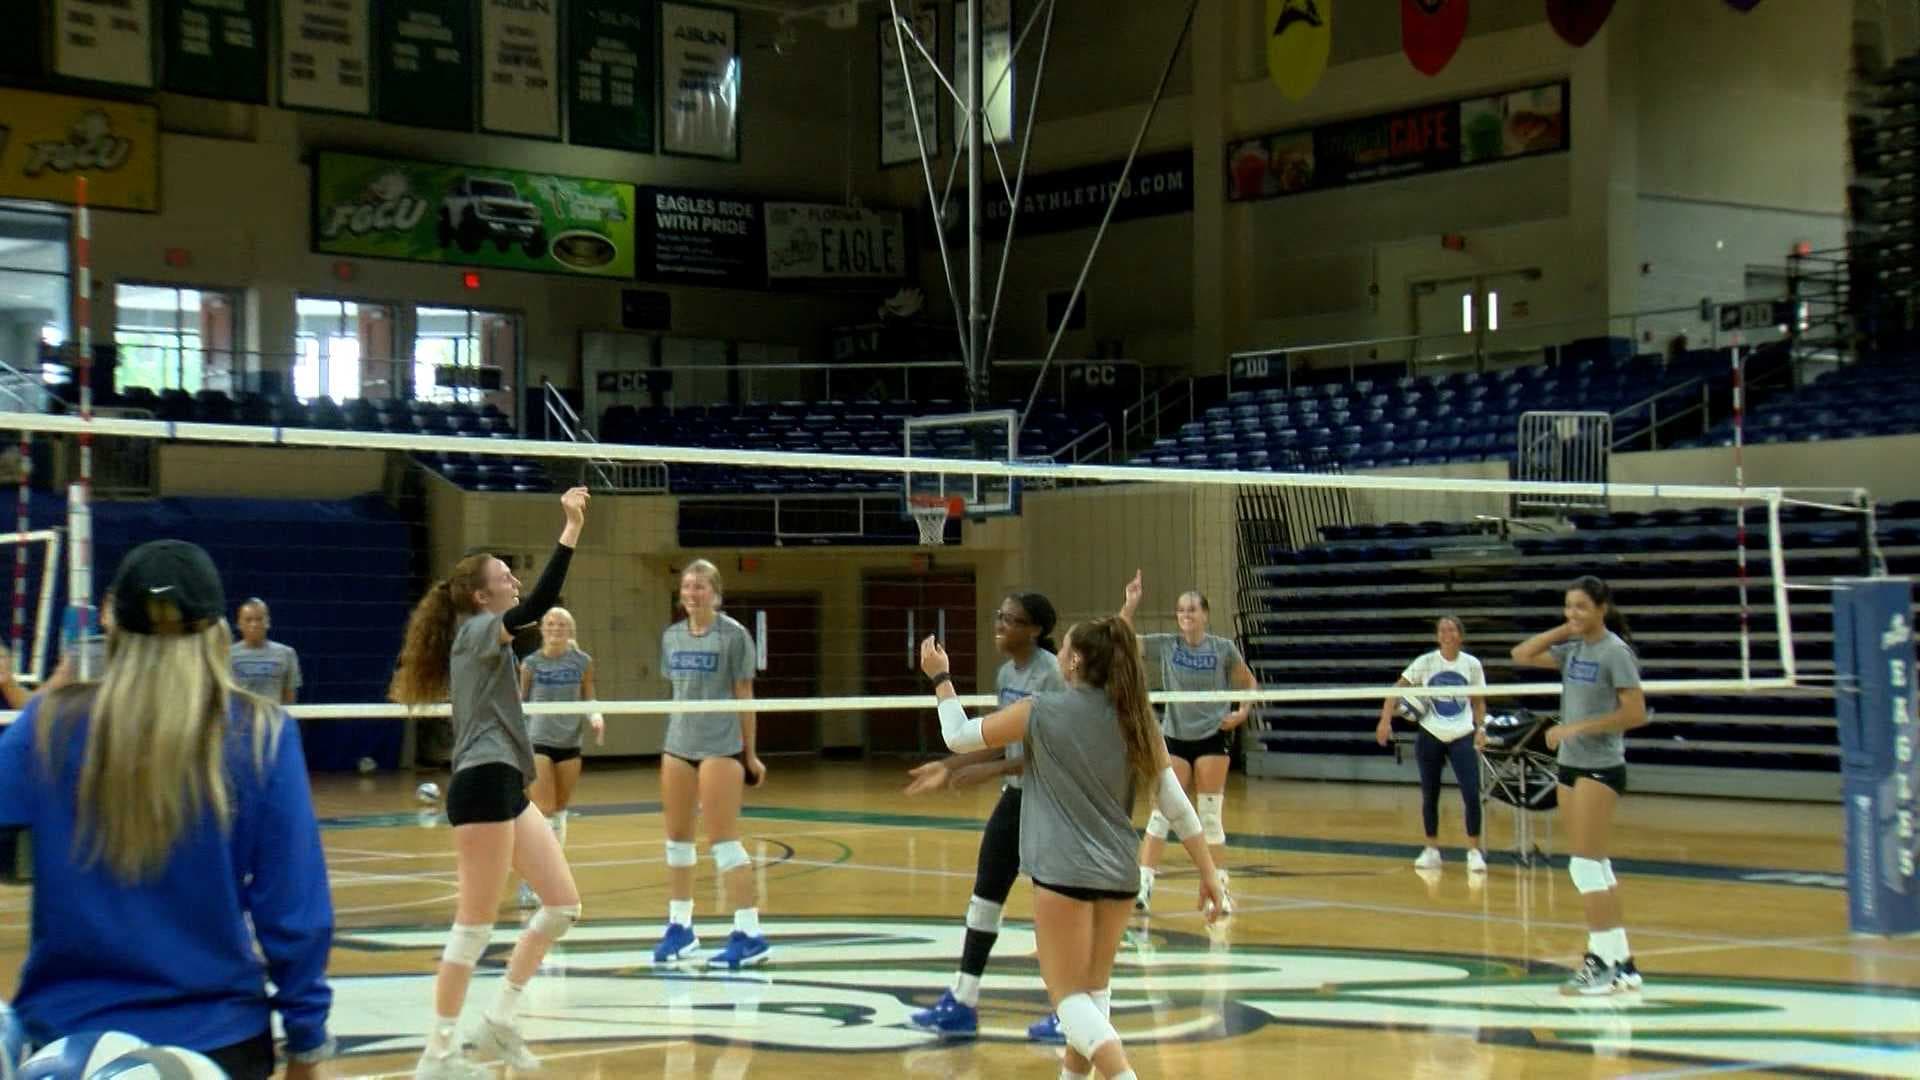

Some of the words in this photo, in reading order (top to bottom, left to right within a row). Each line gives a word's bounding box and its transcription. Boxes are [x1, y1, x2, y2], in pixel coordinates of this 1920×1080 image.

[655, 193, 716, 214] EAGLES
[718, 201, 753, 217] RIDE
[655, 213, 699, 231] WITH
[702, 216, 748, 235] PRIDE
[821, 228, 897, 273] EAGLE
[616, 371, 649, 391] CC
[1085, 365, 1117, 385] CC
